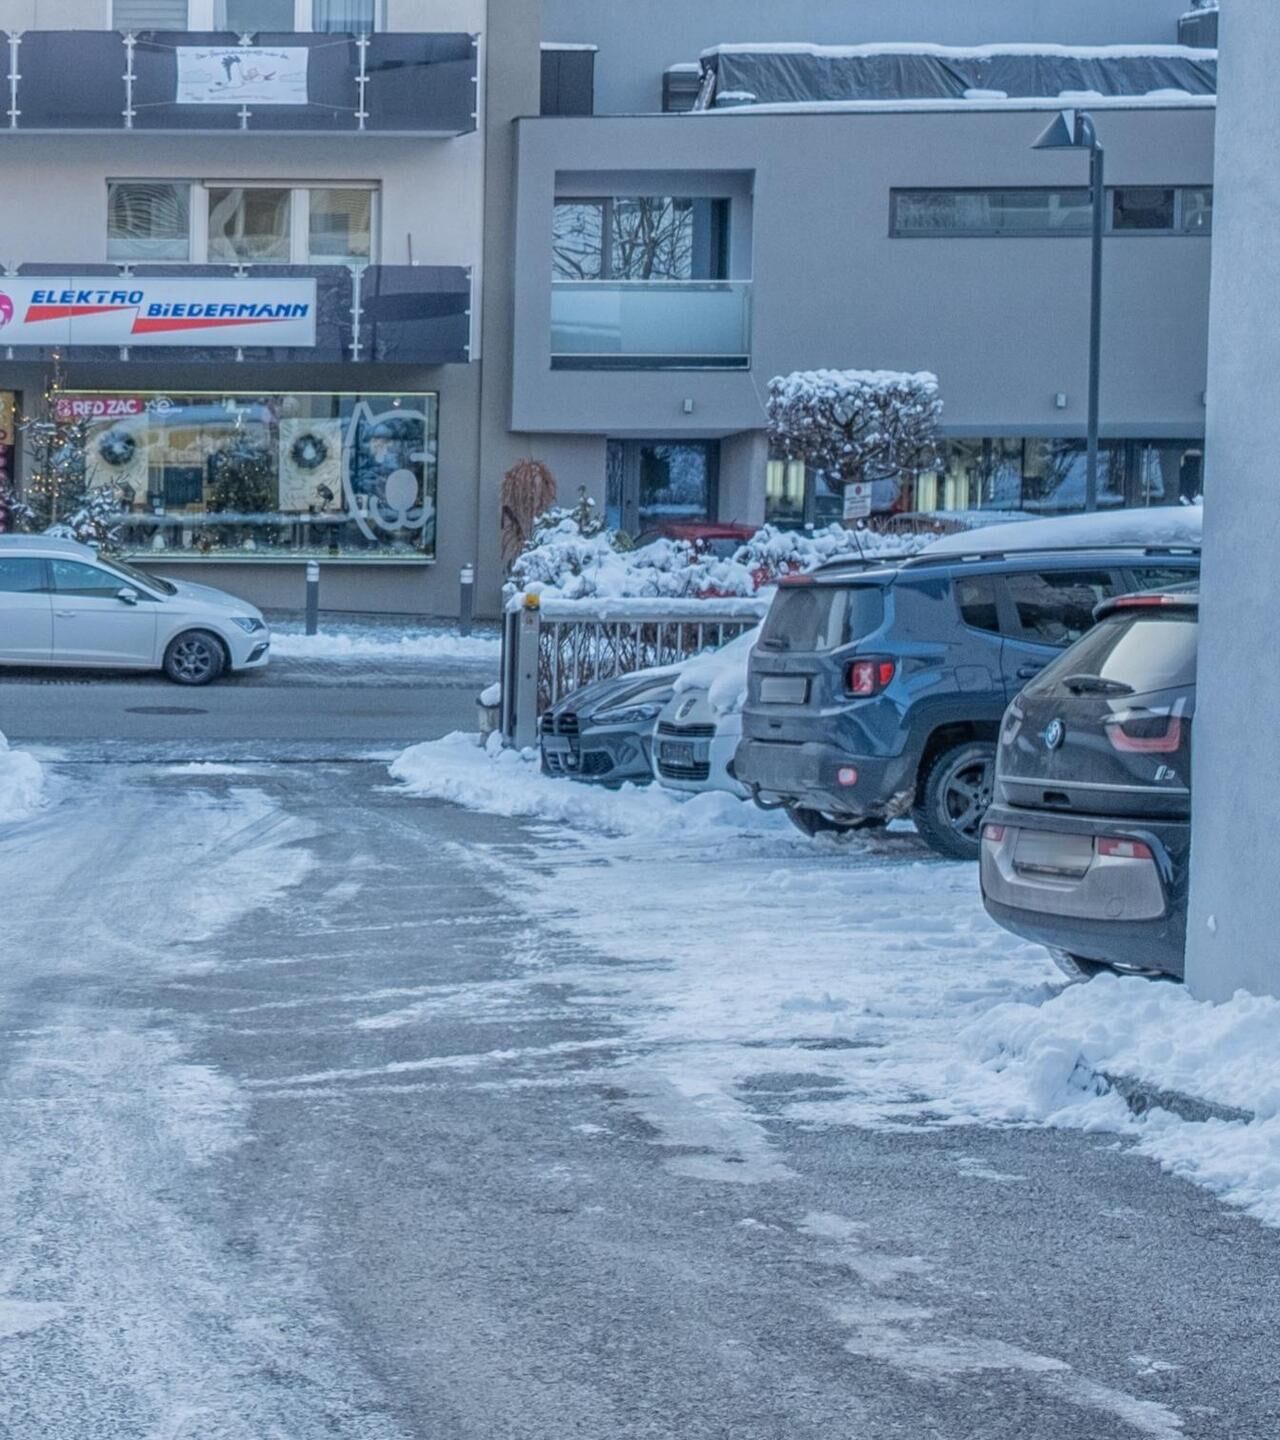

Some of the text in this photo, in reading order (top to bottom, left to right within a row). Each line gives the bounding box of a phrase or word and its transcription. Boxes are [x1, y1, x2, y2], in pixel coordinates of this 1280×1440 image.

[31, 290, 144, 304] ELEKTRO
[72, 399, 137, 415] RED ZAC
